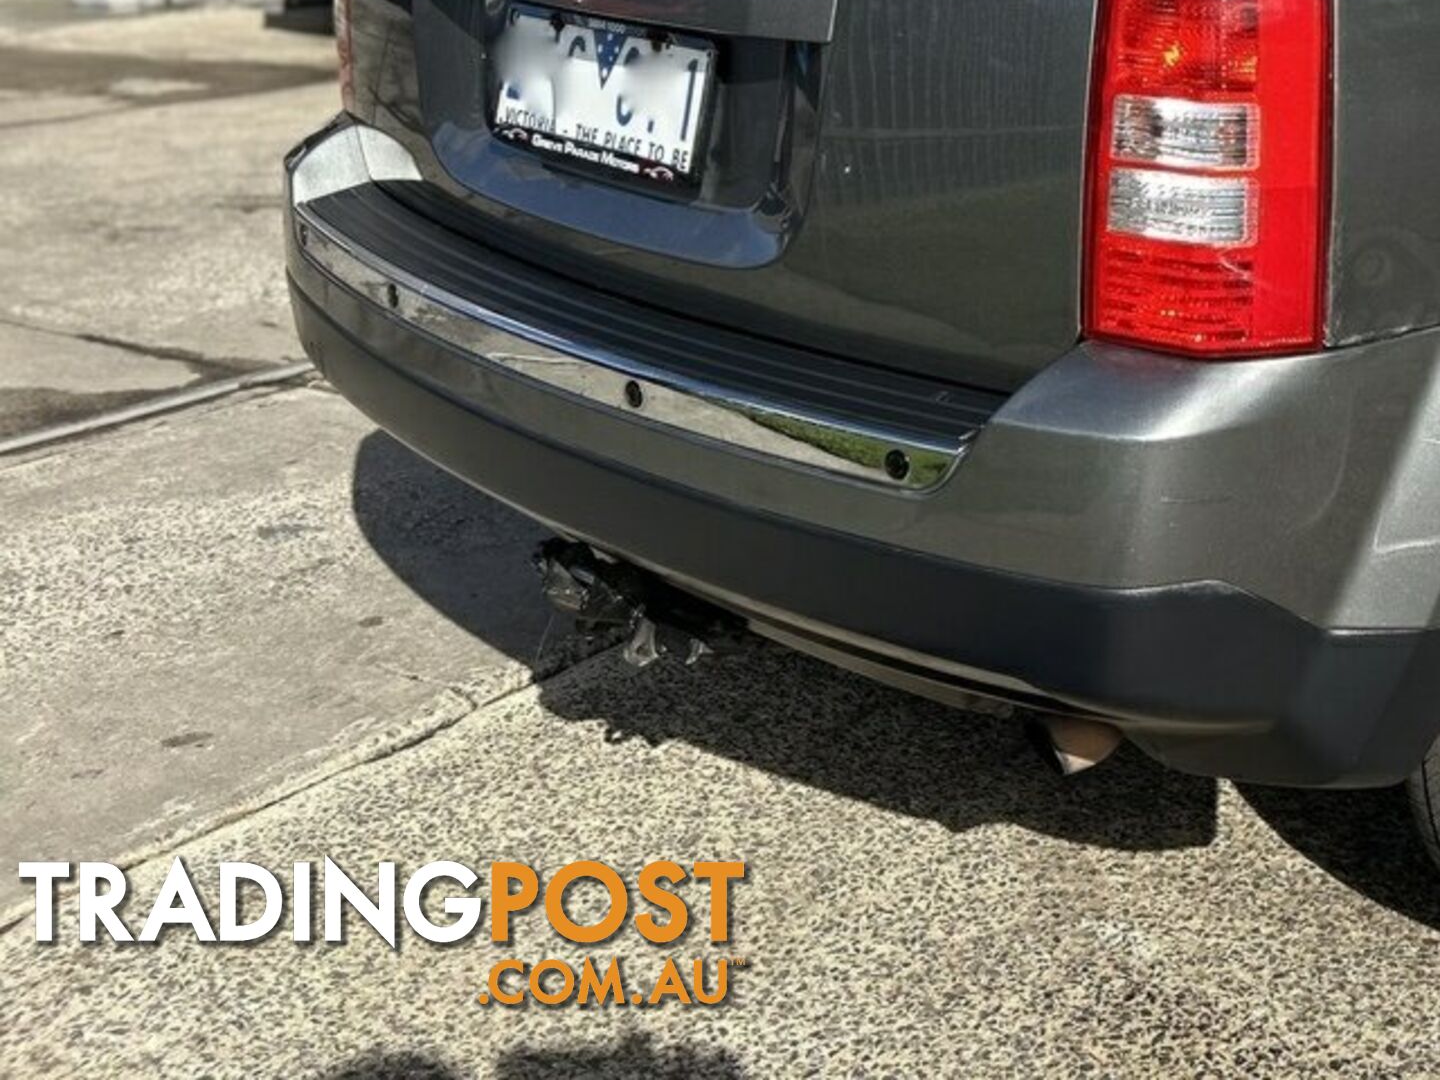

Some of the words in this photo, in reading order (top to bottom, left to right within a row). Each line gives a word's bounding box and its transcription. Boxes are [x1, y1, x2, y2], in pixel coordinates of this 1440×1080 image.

[504, 105, 556, 132] VICTORIA
[575, 123, 599, 143] THE
[603, 131, 643, 155] PLACE
[648, 143, 665, 162] TO
[672, 149, 690, 172] BE
